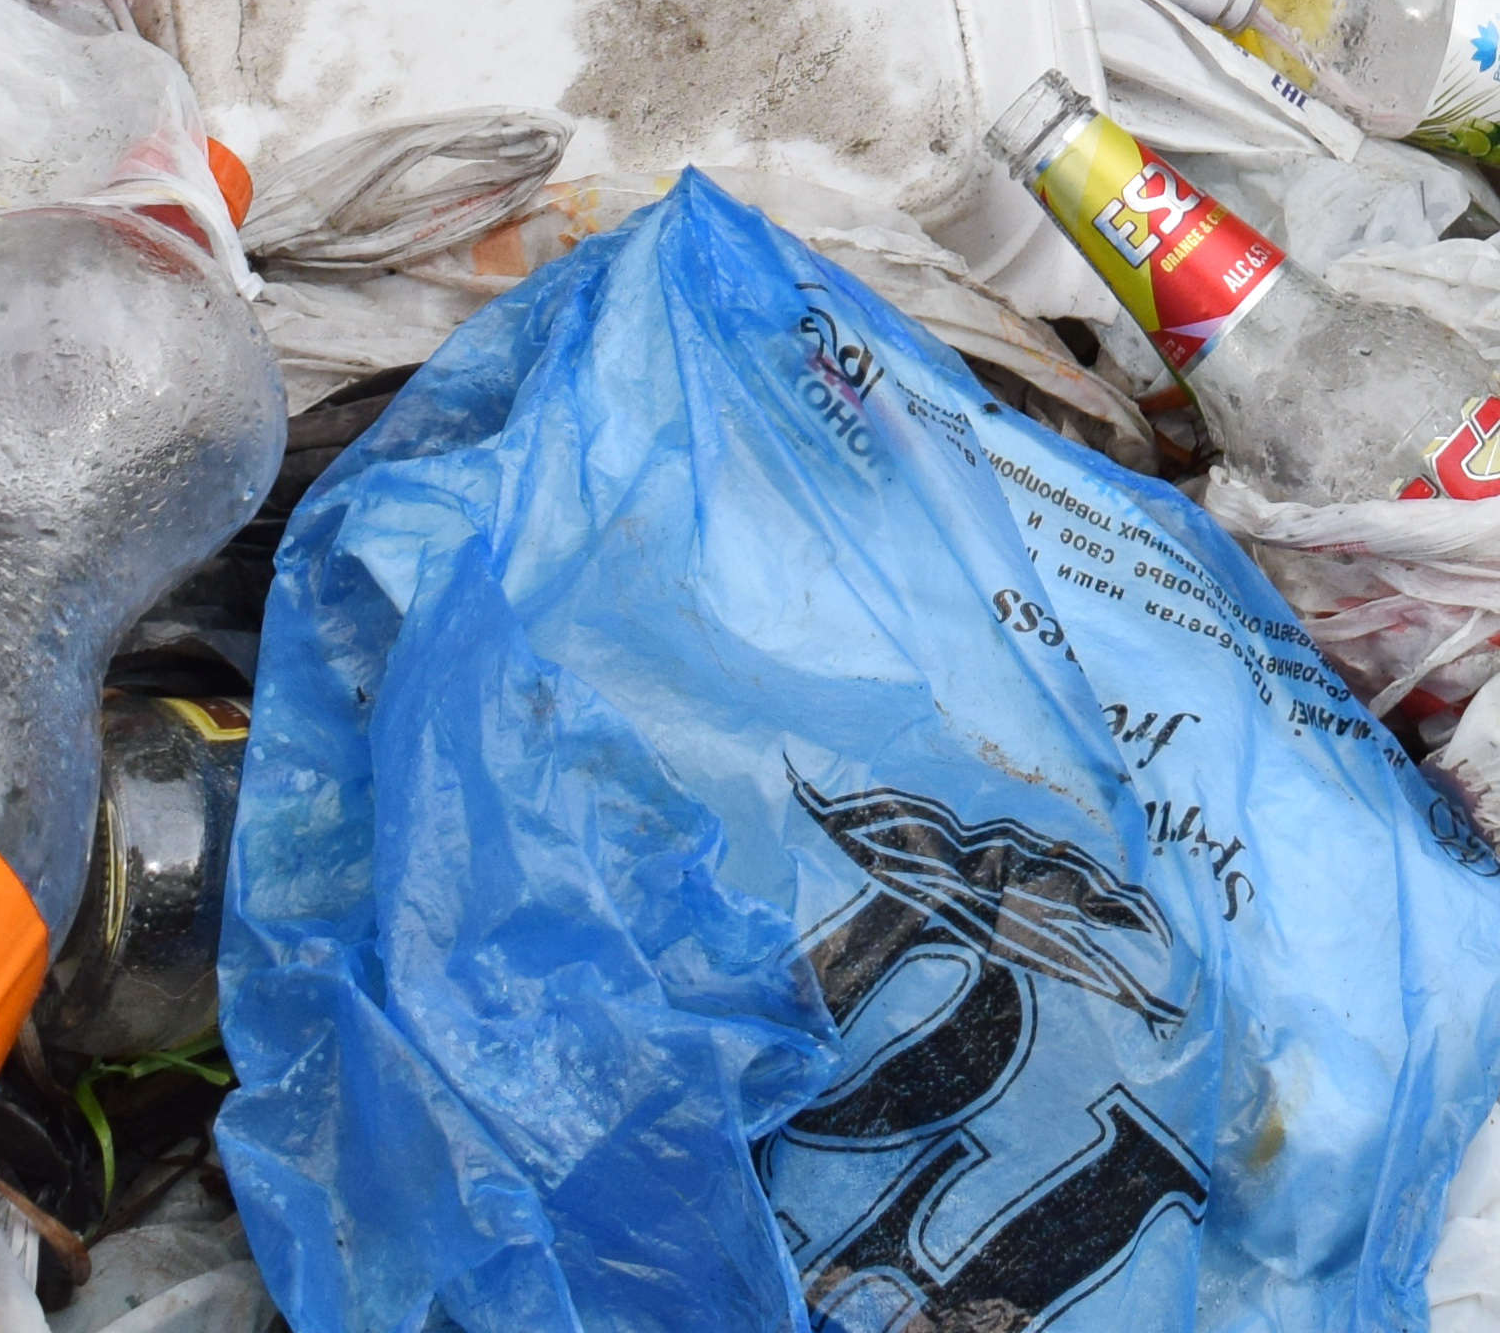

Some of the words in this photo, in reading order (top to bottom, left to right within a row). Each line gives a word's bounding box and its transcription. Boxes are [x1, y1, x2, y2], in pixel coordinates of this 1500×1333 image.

[1159, 223, 1206, 275] ORANGE
[1222, 264, 1253, 296] ALC
[1059, 527, 1116, 565] свое
[1056, 563, 1126, 602] наши
